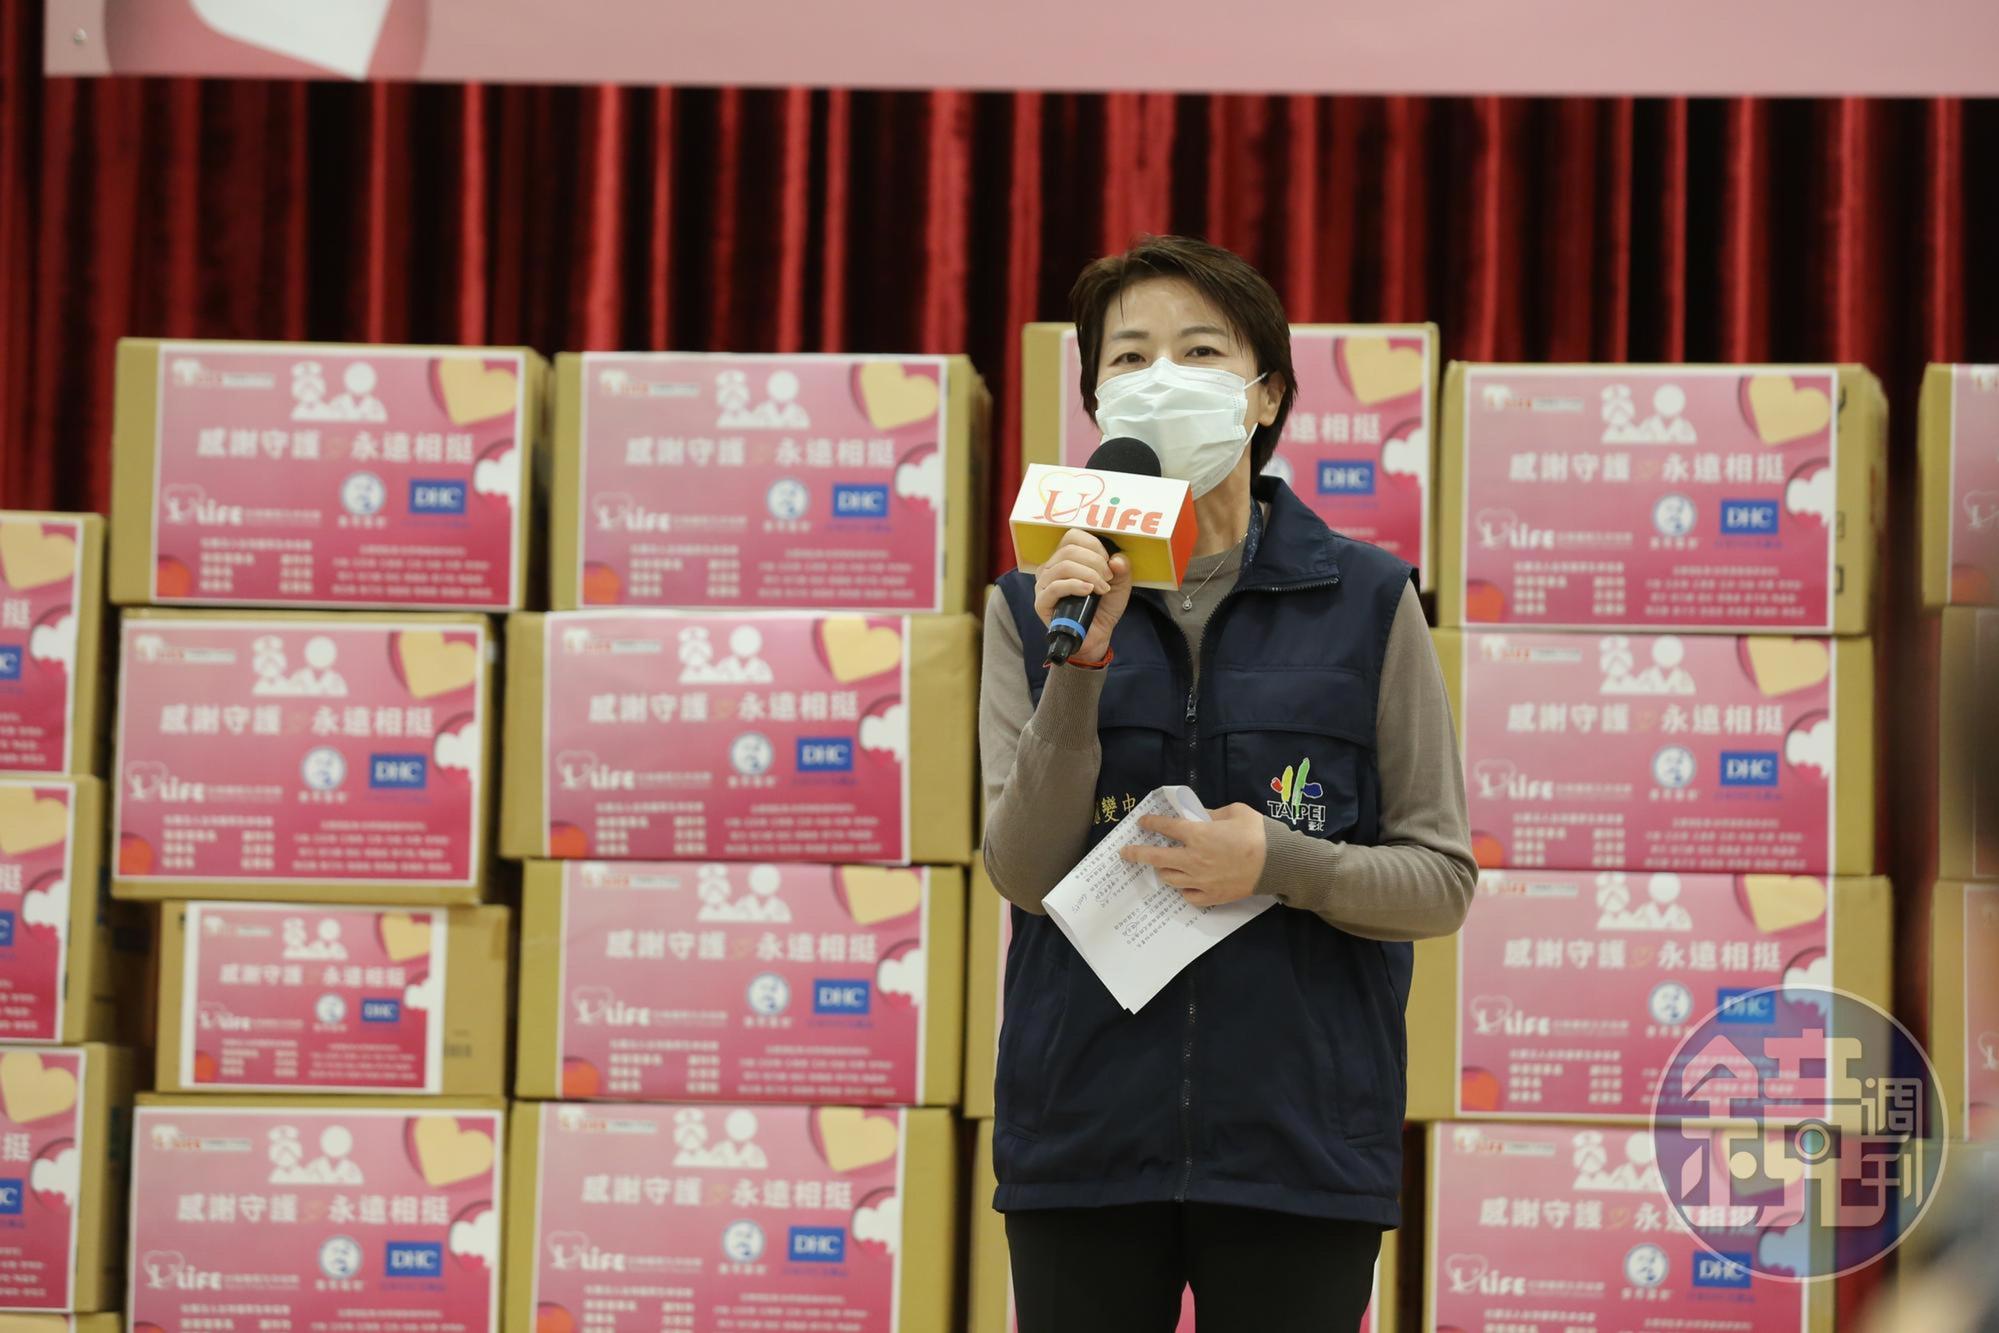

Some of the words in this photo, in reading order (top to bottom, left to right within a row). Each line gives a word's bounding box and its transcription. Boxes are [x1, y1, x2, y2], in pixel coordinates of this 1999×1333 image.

[1281, 413, 1382, 445] 遠相挺
[196, 427, 321, 461] 感謝守護
[350, 429, 474, 466] 永遠相挺
[625, 436, 745, 469] 感謝守護
[775, 435, 894, 471] 永遠相挺
[1322, 466, 1369, 489] DHC
[1507, 451, 1632, 485] 感謝守護
[1661, 449, 1785, 486] 永遠相挺
[414, 485, 461, 508] DHC
[838, 490, 883, 511] DHC
[1726, 505, 1773, 528] DHC
[588, 692, 708, 725] 感謝守護
[738, 688, 857, 724] 永遠相挺
[158, 703, 283, 737] 感謝守護
[310, 703, 434, 740] 永遠相挺
[1505, 702, 1630, 736] 感謝守護
[1660, 701, 1784, 738] 永遠相挺
[802, 743, 847, 764] DHC
[374, 759, 421, 782] DHC
[1725, 757, 1772, 780] DHC
[1267, 800, 1326, 822] TAIPEI
[605, 929, 728, 963] 感謝守護
[757, 930, 878, 966] 永遠相挺
[1502, 937, 1627, 971] 感謝守護
[1657, 938, 1781, 975] 永遠相挺
[220, 963, 304, 987] 感謝守護
[323, 965, 406, 989] 永遠相挺
[819, 986, 864, 1007] DHC
[1723, 996, 1769, 1019] DHC
[363, 1001, 395, 1020] DHC
[581, 1174, 704, 1208] 感謝守護
[732, 1177, 853, 1213] 永遠相挺
[175, 1192, 299, 1226] 感謝守護
[326, 1191, 450, 1228] 永遠相挺
[1478, 1197, 1603, 1231] 感謝守護
[794, 1233, 839, 1254] DHC
[391, 1248, 436, 1269] DHC
[1698, 1258, 1745, 1281] DHC
